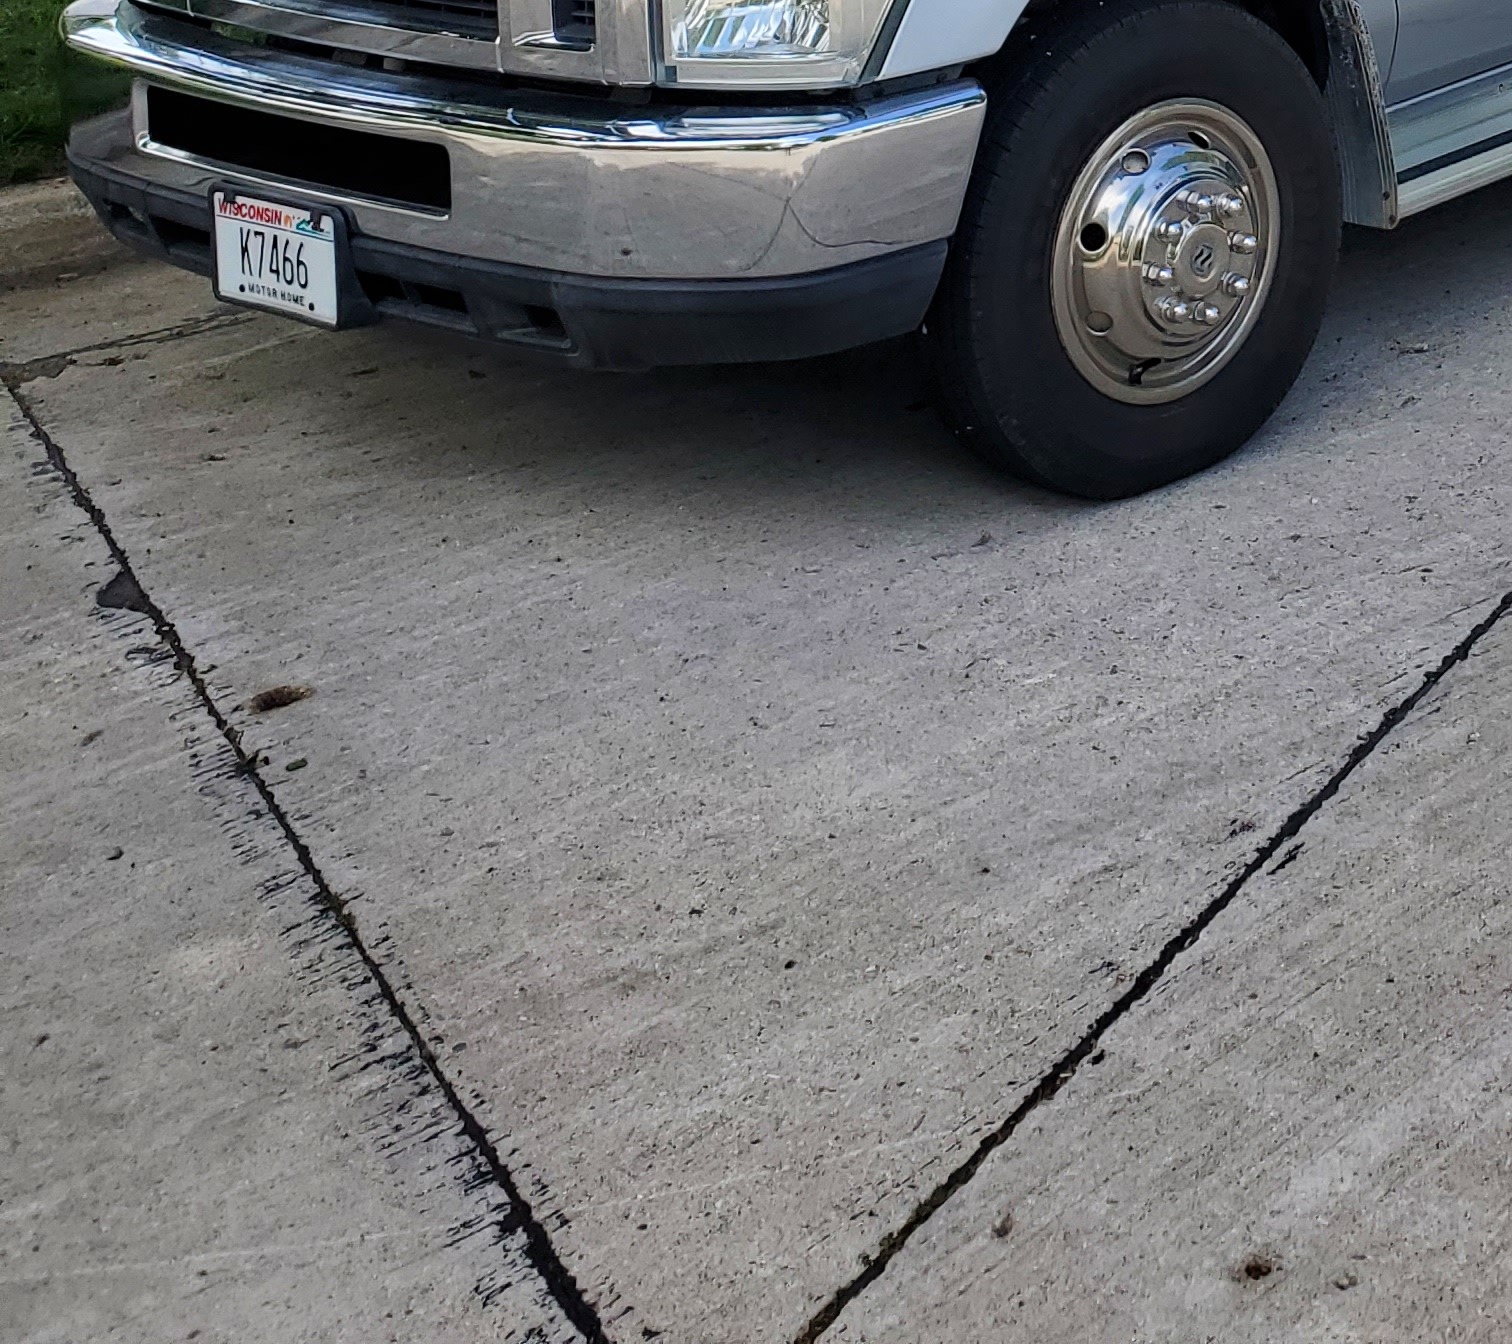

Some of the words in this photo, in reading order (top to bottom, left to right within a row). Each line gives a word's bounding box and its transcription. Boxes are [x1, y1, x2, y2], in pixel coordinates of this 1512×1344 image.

[218, 198, 283, 226] WISCONSIN
[239, 226, 309, 290] K7466
[248, 283, 278, 300] MOTOR
[280, 289, 305, 307] HOME
